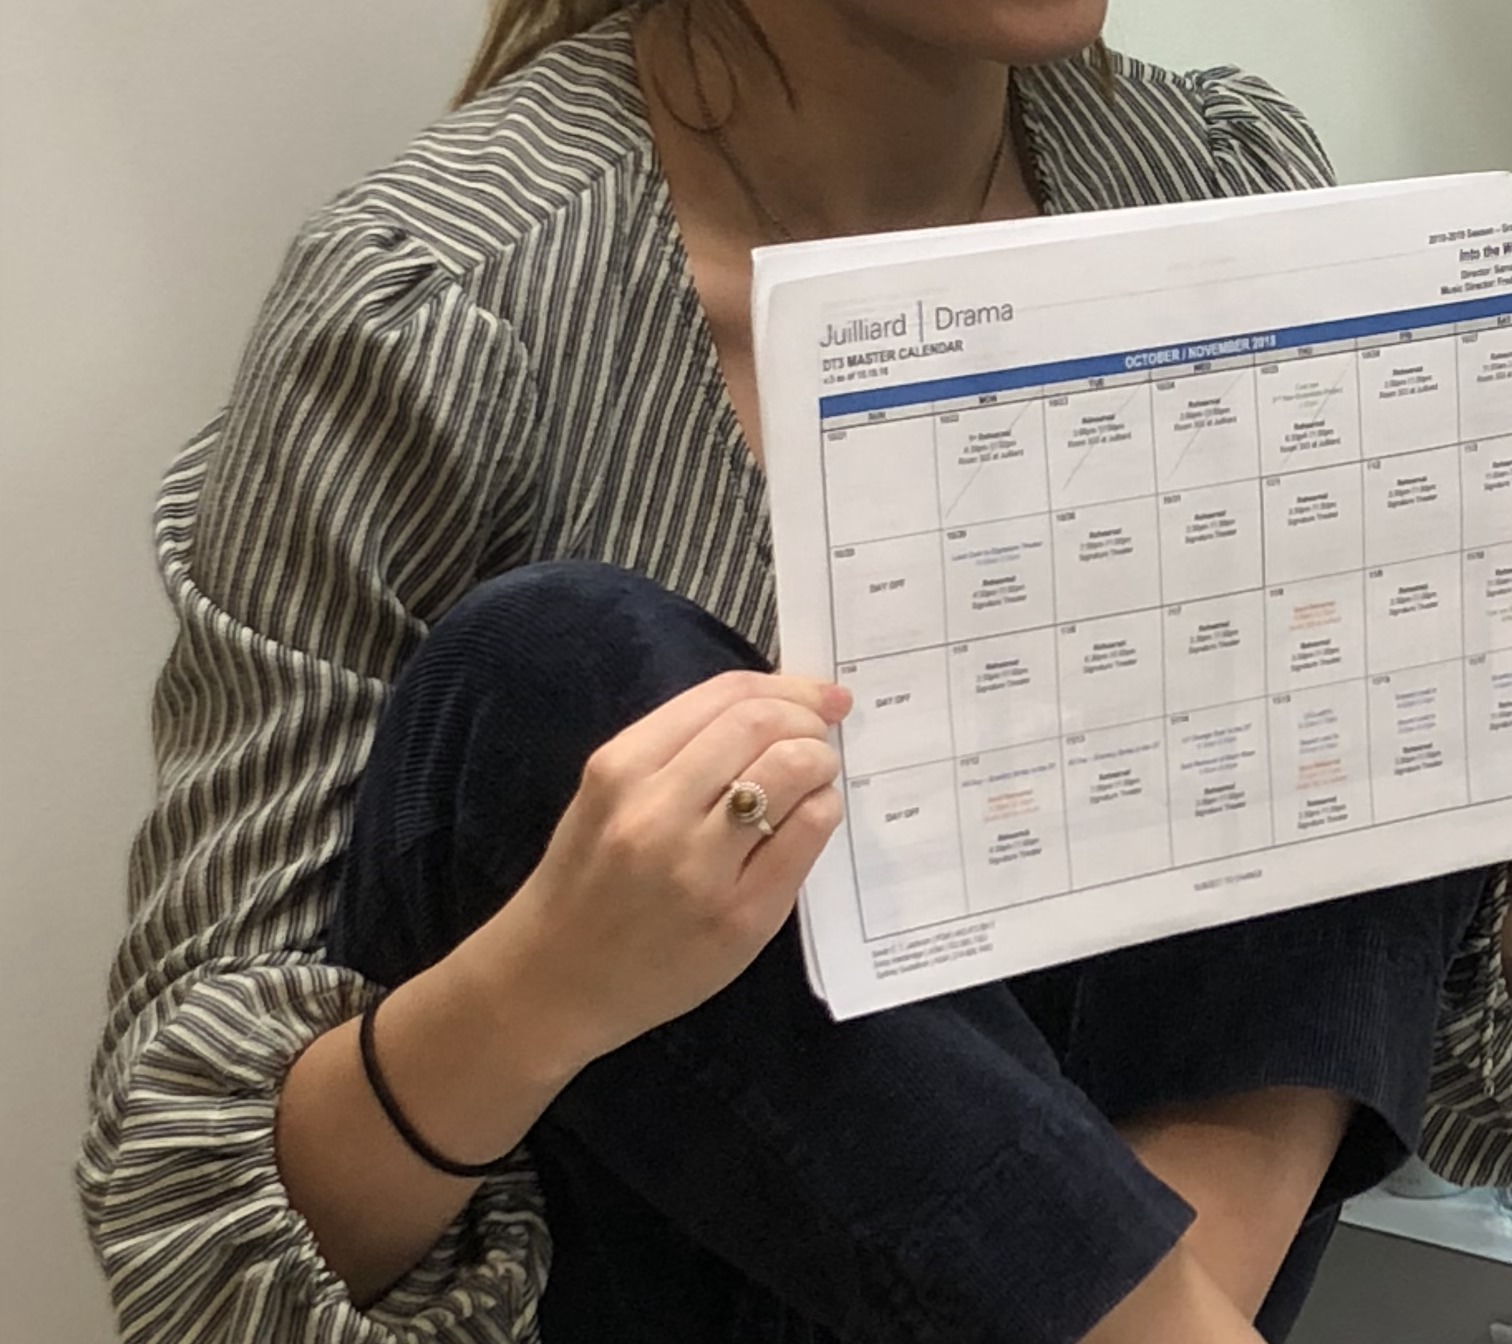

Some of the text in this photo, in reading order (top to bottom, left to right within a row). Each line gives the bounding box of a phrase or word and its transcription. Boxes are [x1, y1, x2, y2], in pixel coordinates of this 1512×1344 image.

[1458, 248, 1480, 261] Into
[1484, 245, 1499, 257] the
[818, 298, 1014, 347] Juilliard Drama
[846, 350, 896, 367] MASTER
[898, 340, 964, 360] CALENDAR
[1124, 350, 1179, 369] OCTOBER
[1187, 340, 1250, 359] NOVEMBER
